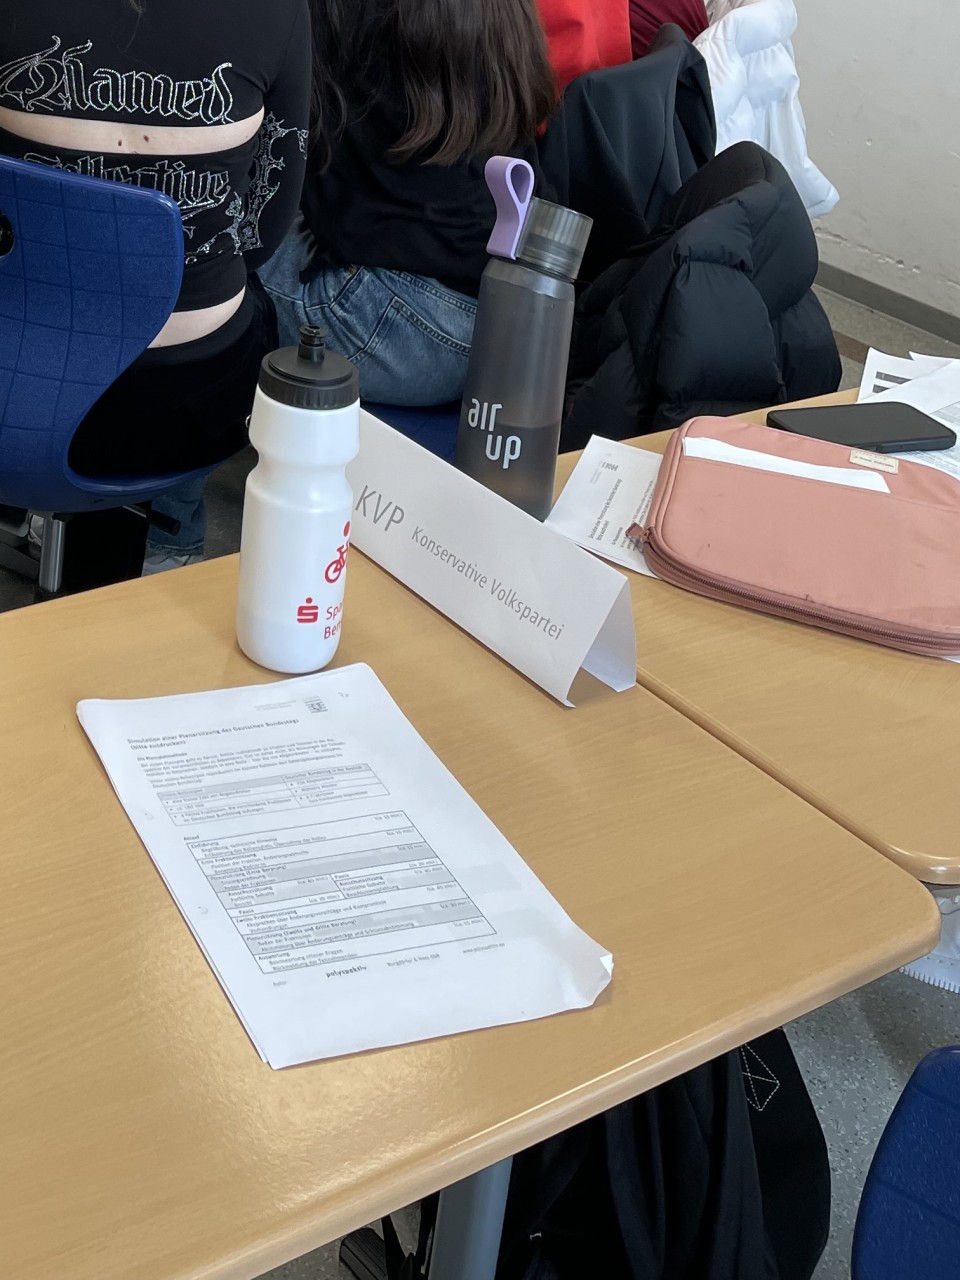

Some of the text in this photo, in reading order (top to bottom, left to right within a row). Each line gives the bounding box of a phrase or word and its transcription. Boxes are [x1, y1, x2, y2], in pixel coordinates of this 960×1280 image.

[468, 398, 503, 432] air
[485, 435, 522, 469] up
[354, 485, 565, 640] KVP Konservative Volkspartei
[325, 965, 367, 976] polyspektiv
